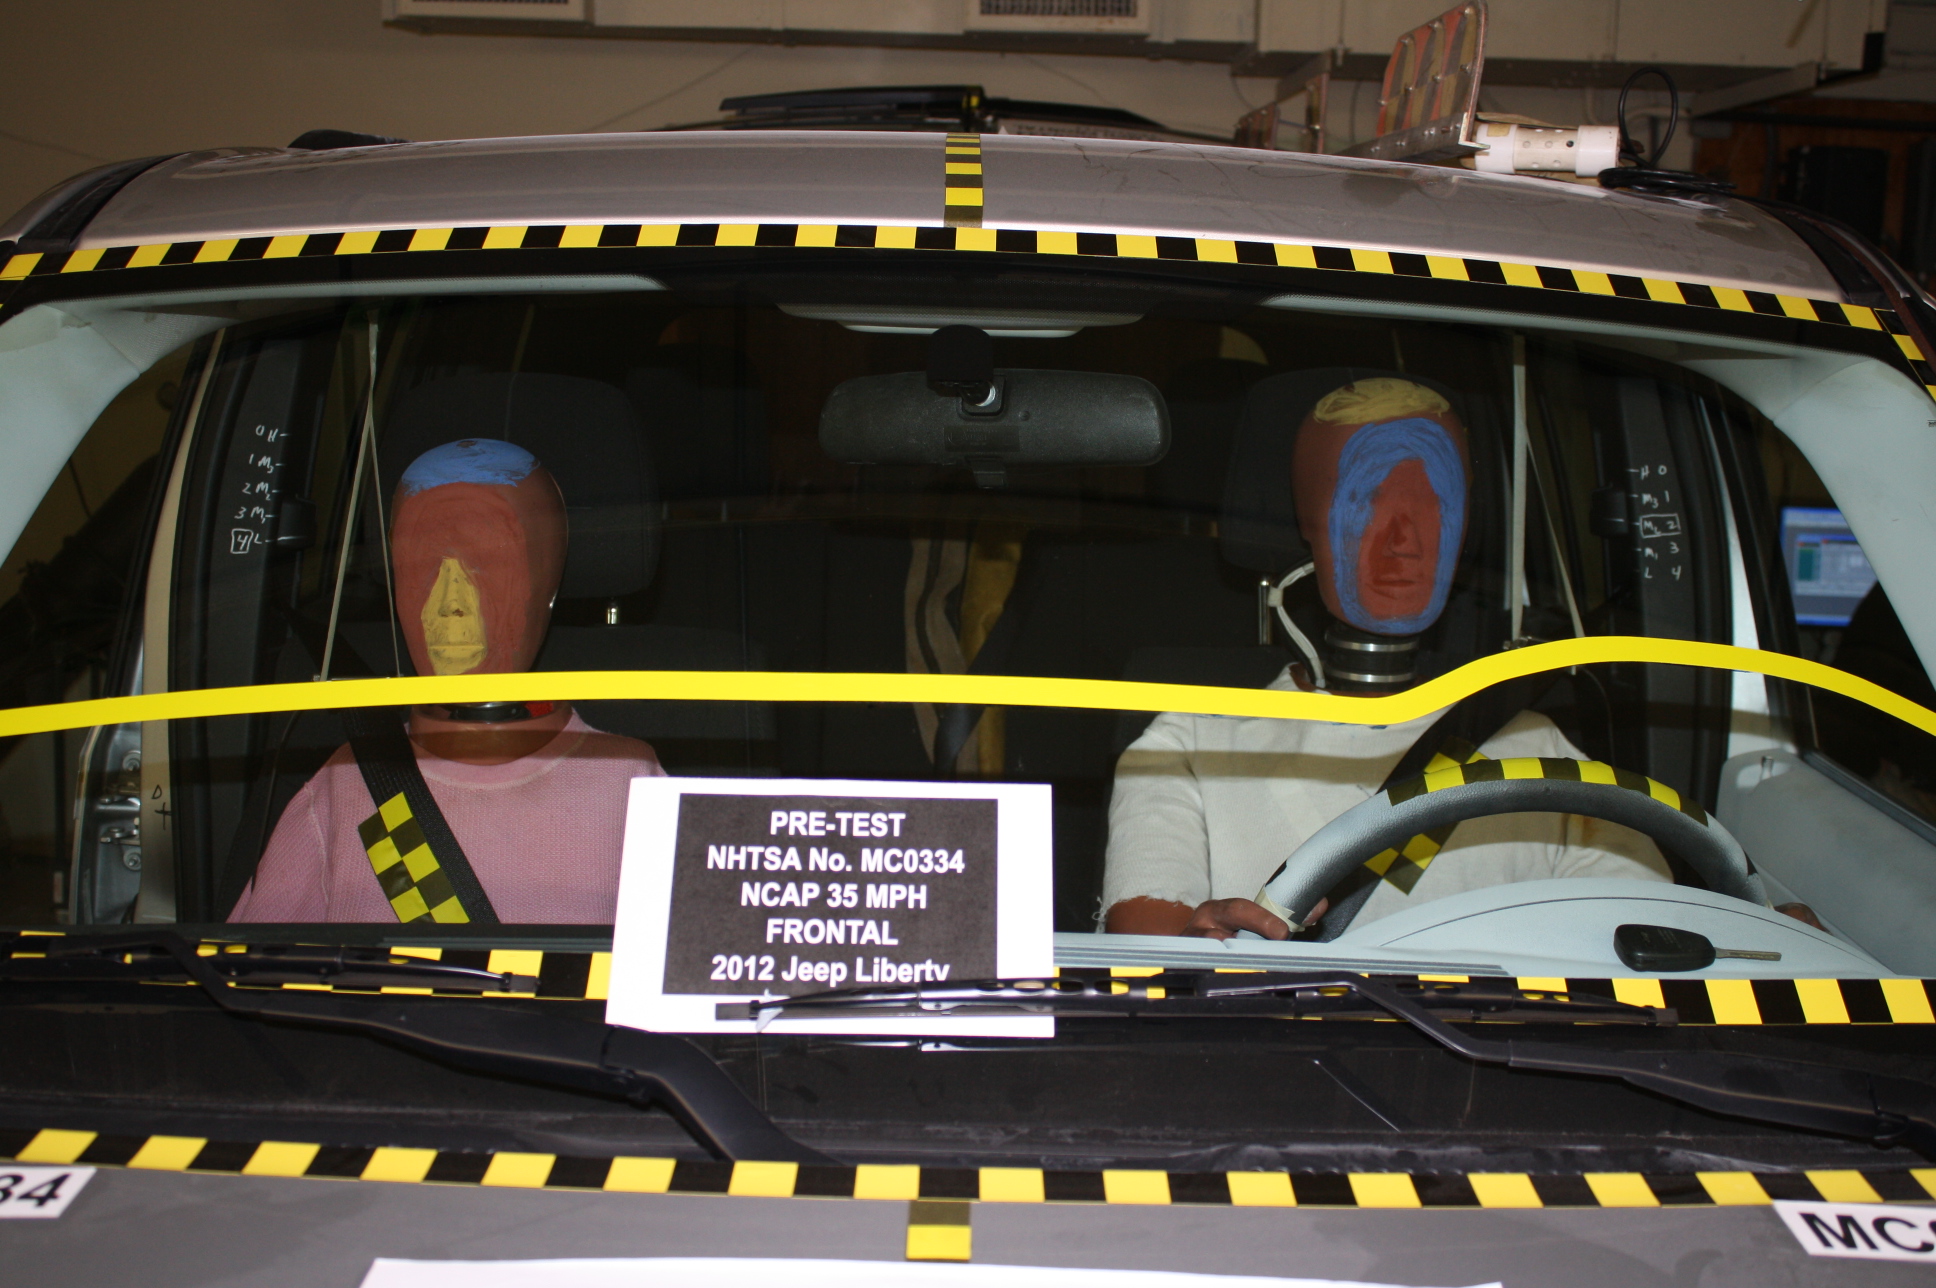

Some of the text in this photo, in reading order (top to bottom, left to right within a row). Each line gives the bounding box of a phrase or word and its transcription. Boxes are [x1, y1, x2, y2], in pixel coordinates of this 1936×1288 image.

[769, 810, 906, 837] PRE-TEST
[706, 845, 966, 874] NHTSA No. MC0334
[740, 881, 928, 910] NCAP 35 MPH
[766, 918, 899, 946] FRONTAL
[710, 954, 775, 982] 2012
[781, 955, 848, 988] Jeep
[1798, 1212, 1936, 1253] MC
